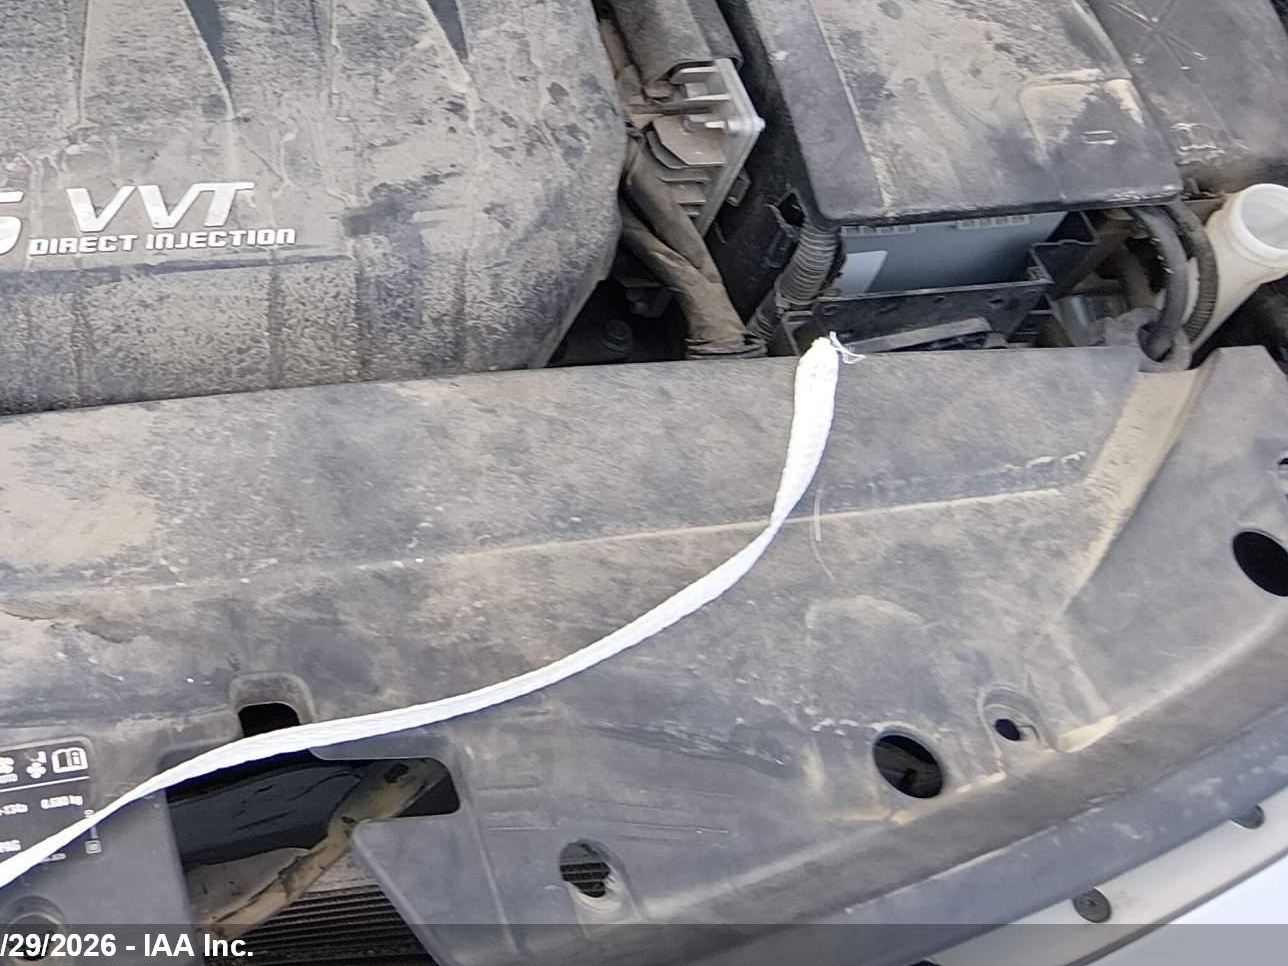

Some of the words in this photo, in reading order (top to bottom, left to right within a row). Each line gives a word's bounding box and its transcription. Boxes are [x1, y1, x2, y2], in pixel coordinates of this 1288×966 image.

[66, 182, 255, 232] VVT
[28, 234, 138, 257] DIRECT
[146, 228, 296, 251] INJECTION
